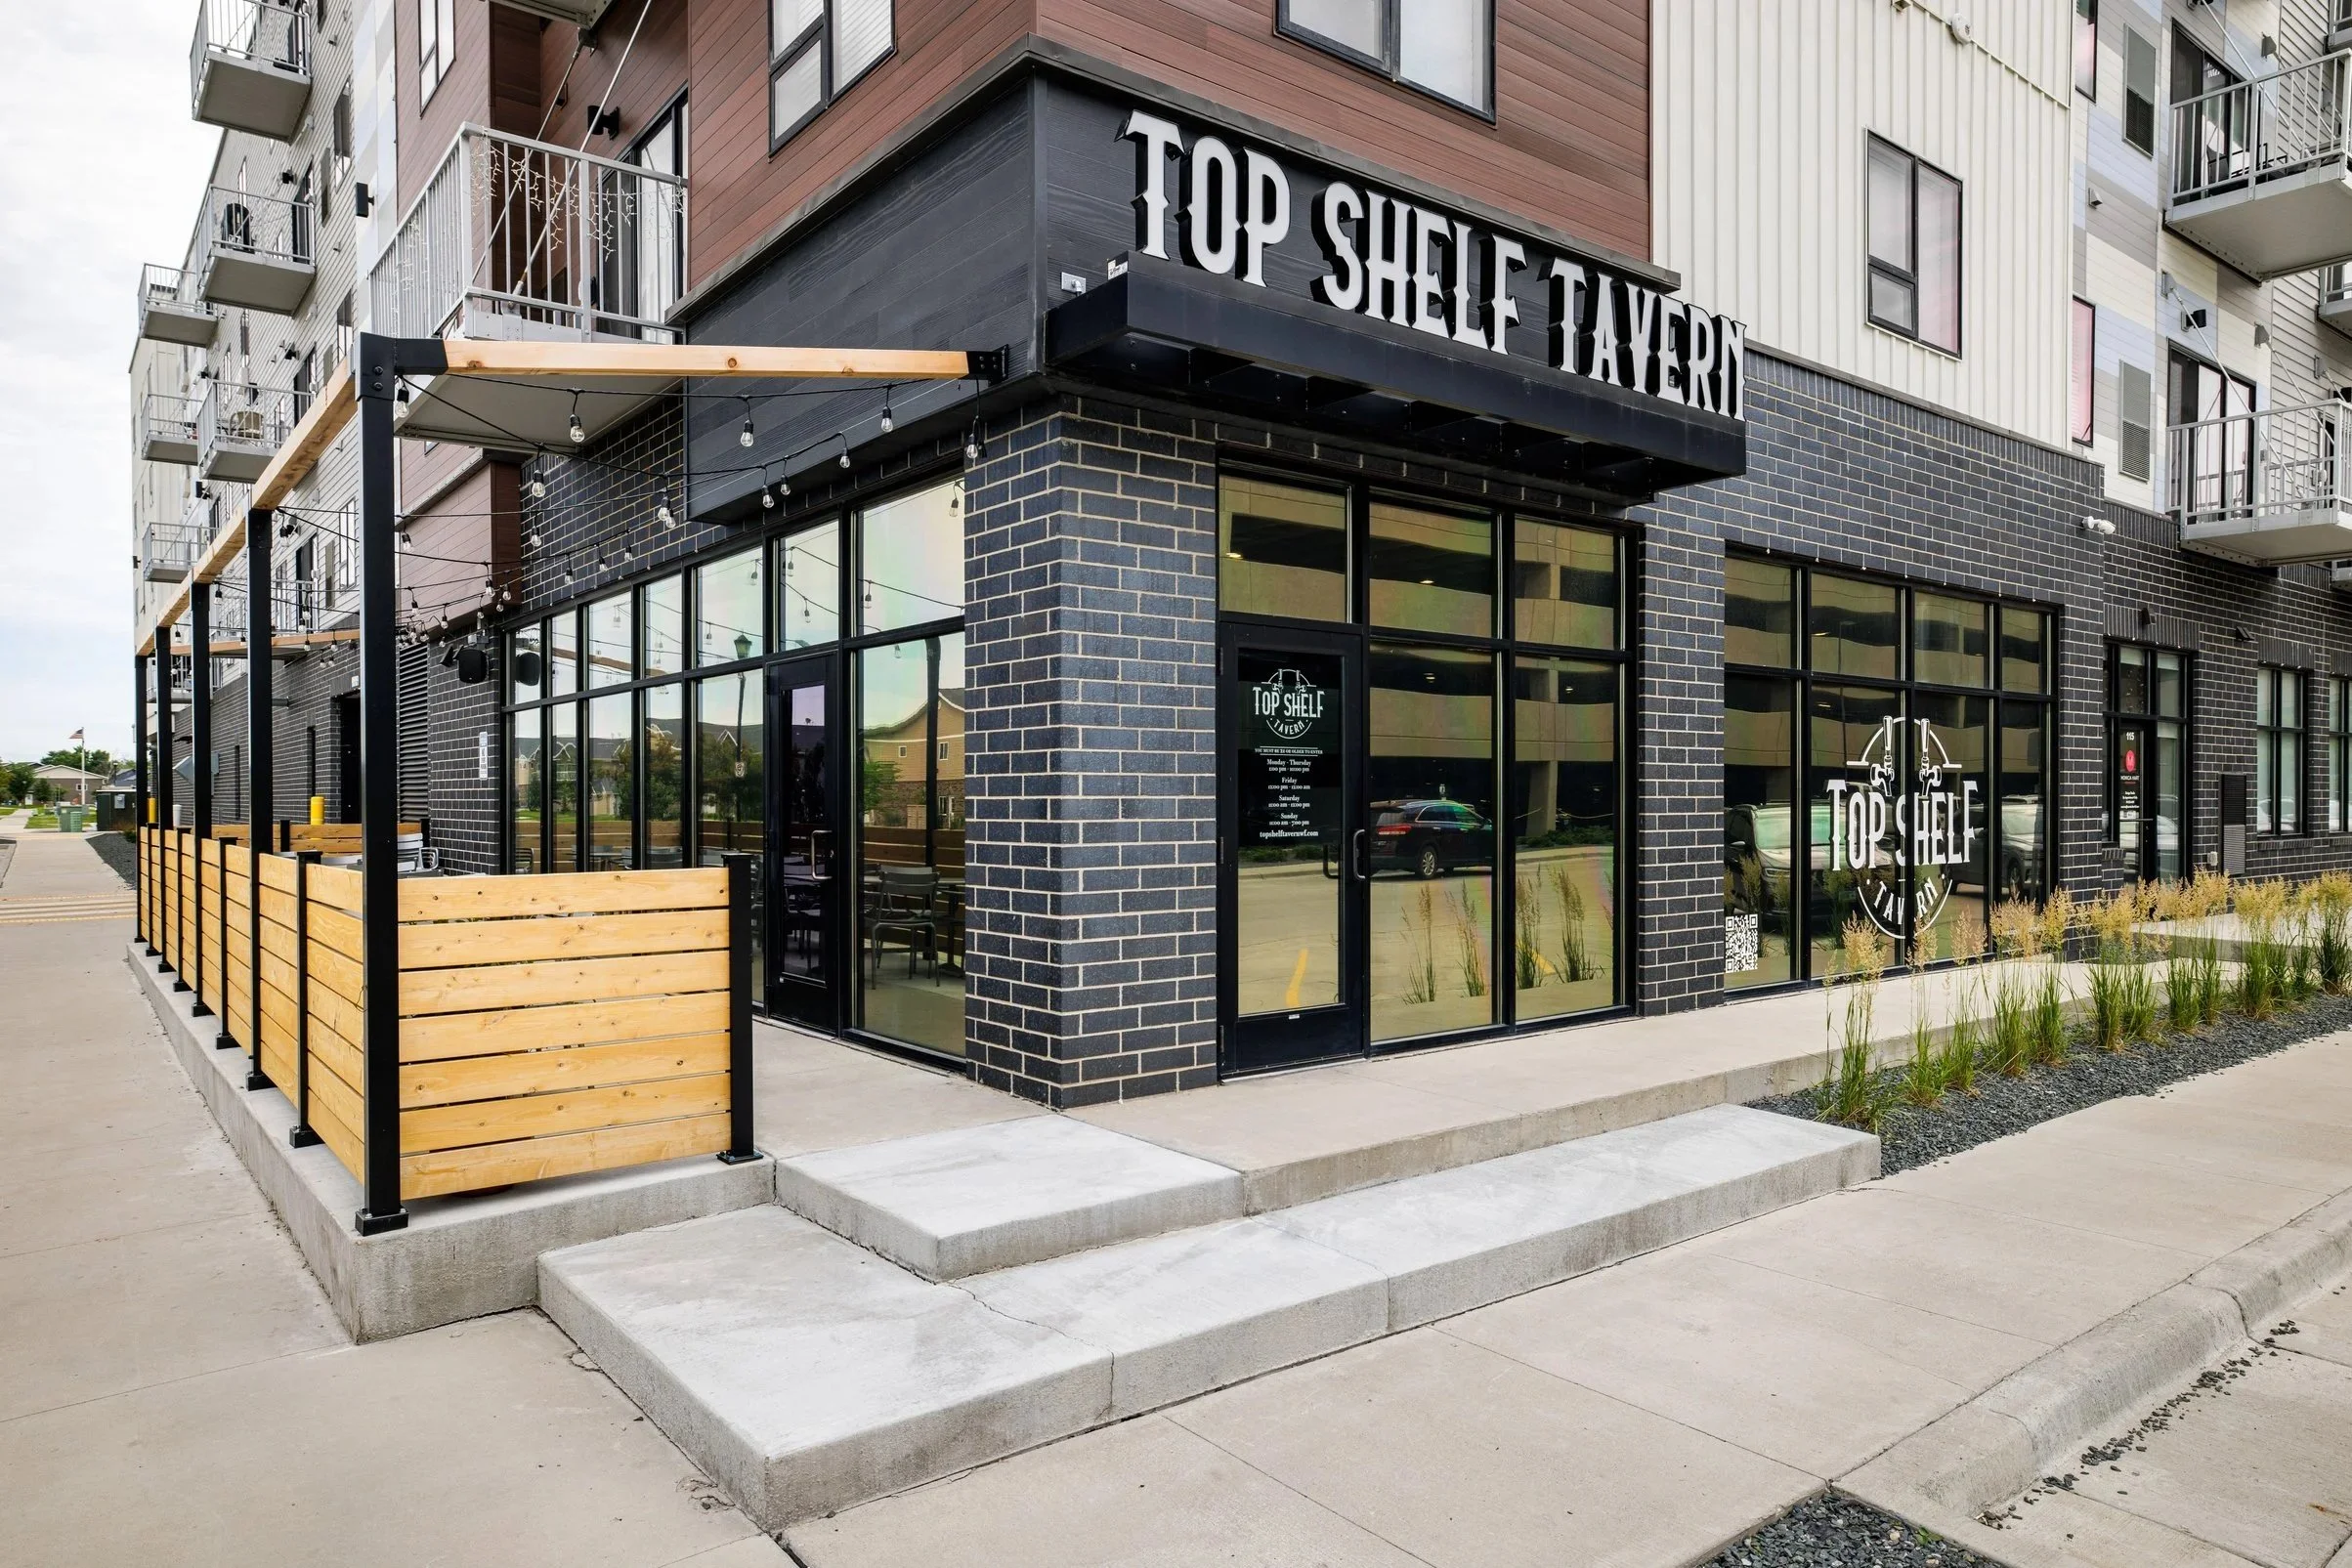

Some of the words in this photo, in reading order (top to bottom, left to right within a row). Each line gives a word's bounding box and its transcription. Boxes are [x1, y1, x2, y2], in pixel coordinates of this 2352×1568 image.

[1120, 109, 1291, 287] TOP
[1317, 181, 1527, 355] SHELF
[1543, 257, 1746, 422] TAVERN
[1253, 687, 1279, 715] TOP
[1284, 690, 1325, 717] SHELF
[1274, 719, 1304, 735] TAVERN
[1289, 759, 1311, 767] Thursday
[1259, 829, 1319, 839] topshelftavernwf.com
[1826, 779, 1887, 870] TOP
[1895, 781, 1979, 867] SHELF
[1874, 876, 1939, 925] TAVRN
